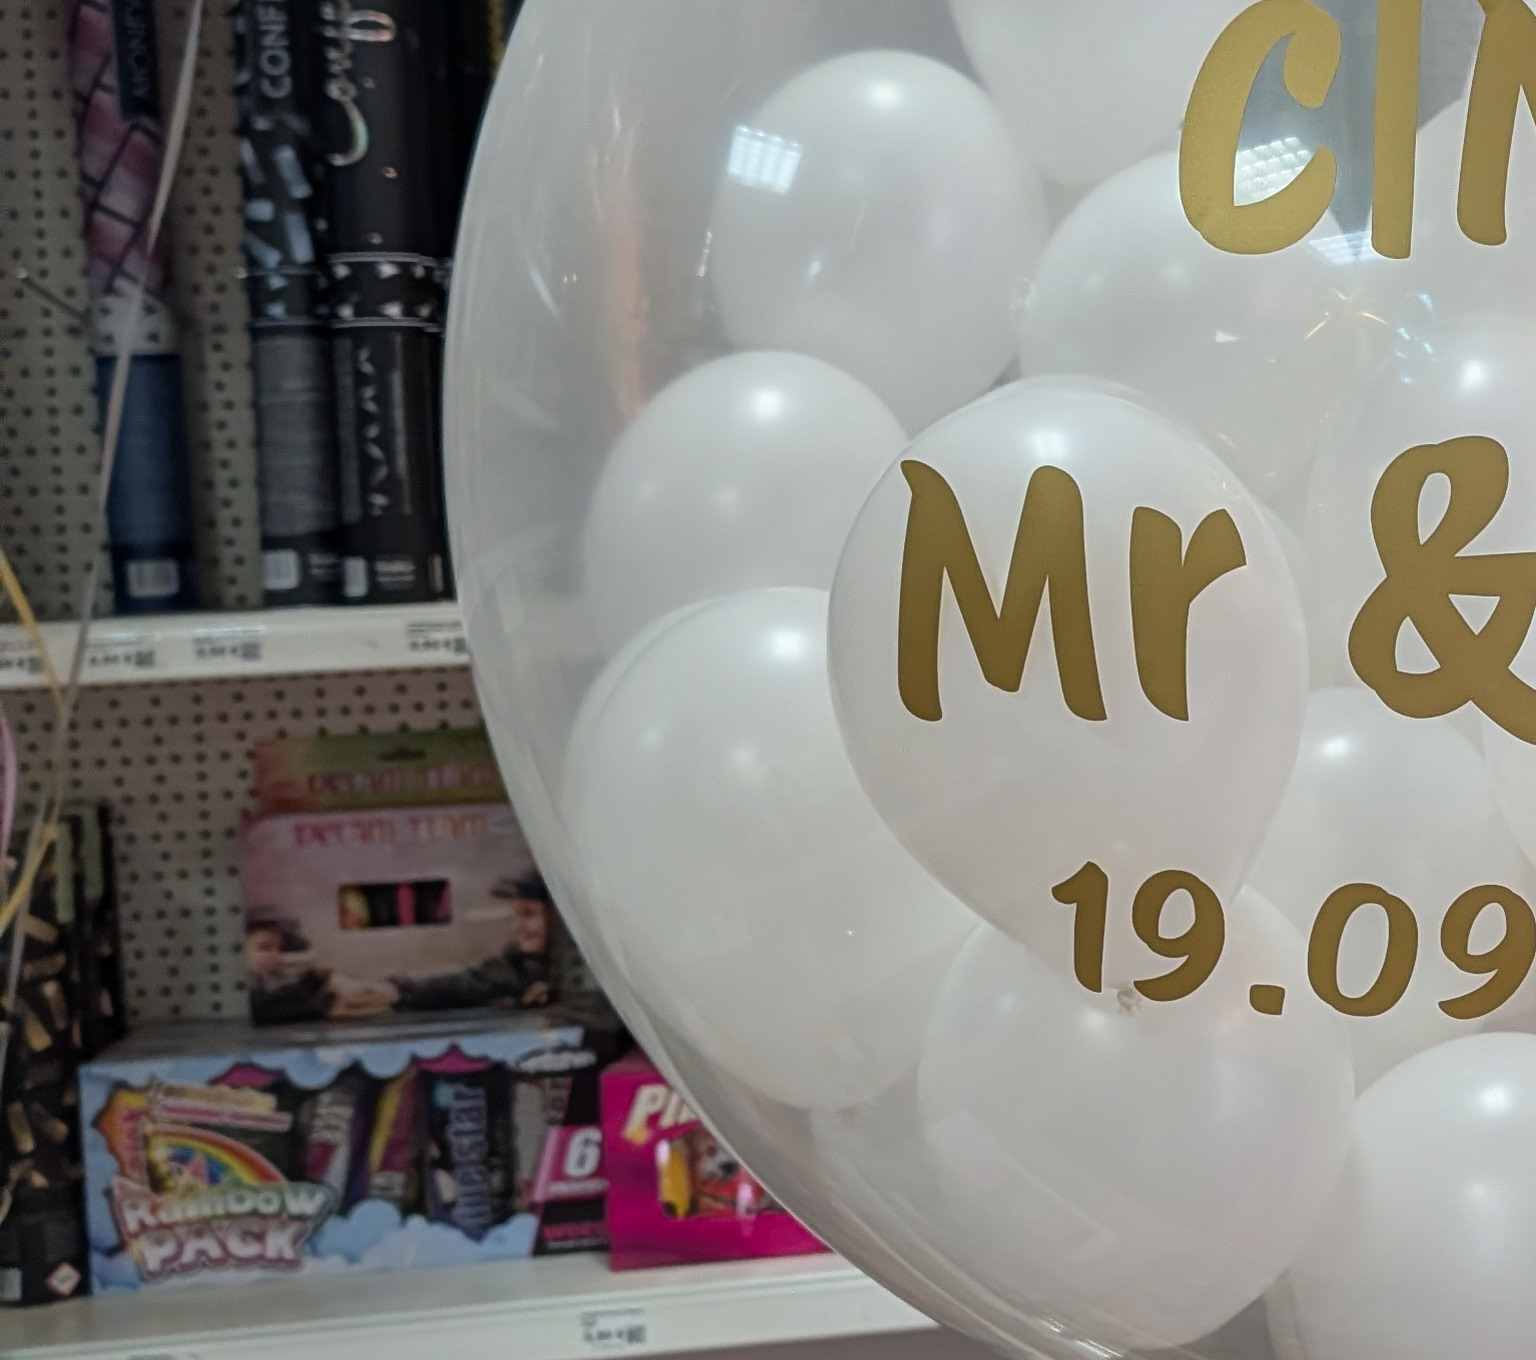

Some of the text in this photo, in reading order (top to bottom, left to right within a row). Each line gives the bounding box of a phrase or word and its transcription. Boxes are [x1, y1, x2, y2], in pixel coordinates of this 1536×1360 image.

[897, 459, 1247, 722] Mr
[563, 1127, 602, 1178] 6
[142, 1217, 304, 1274] PACK
